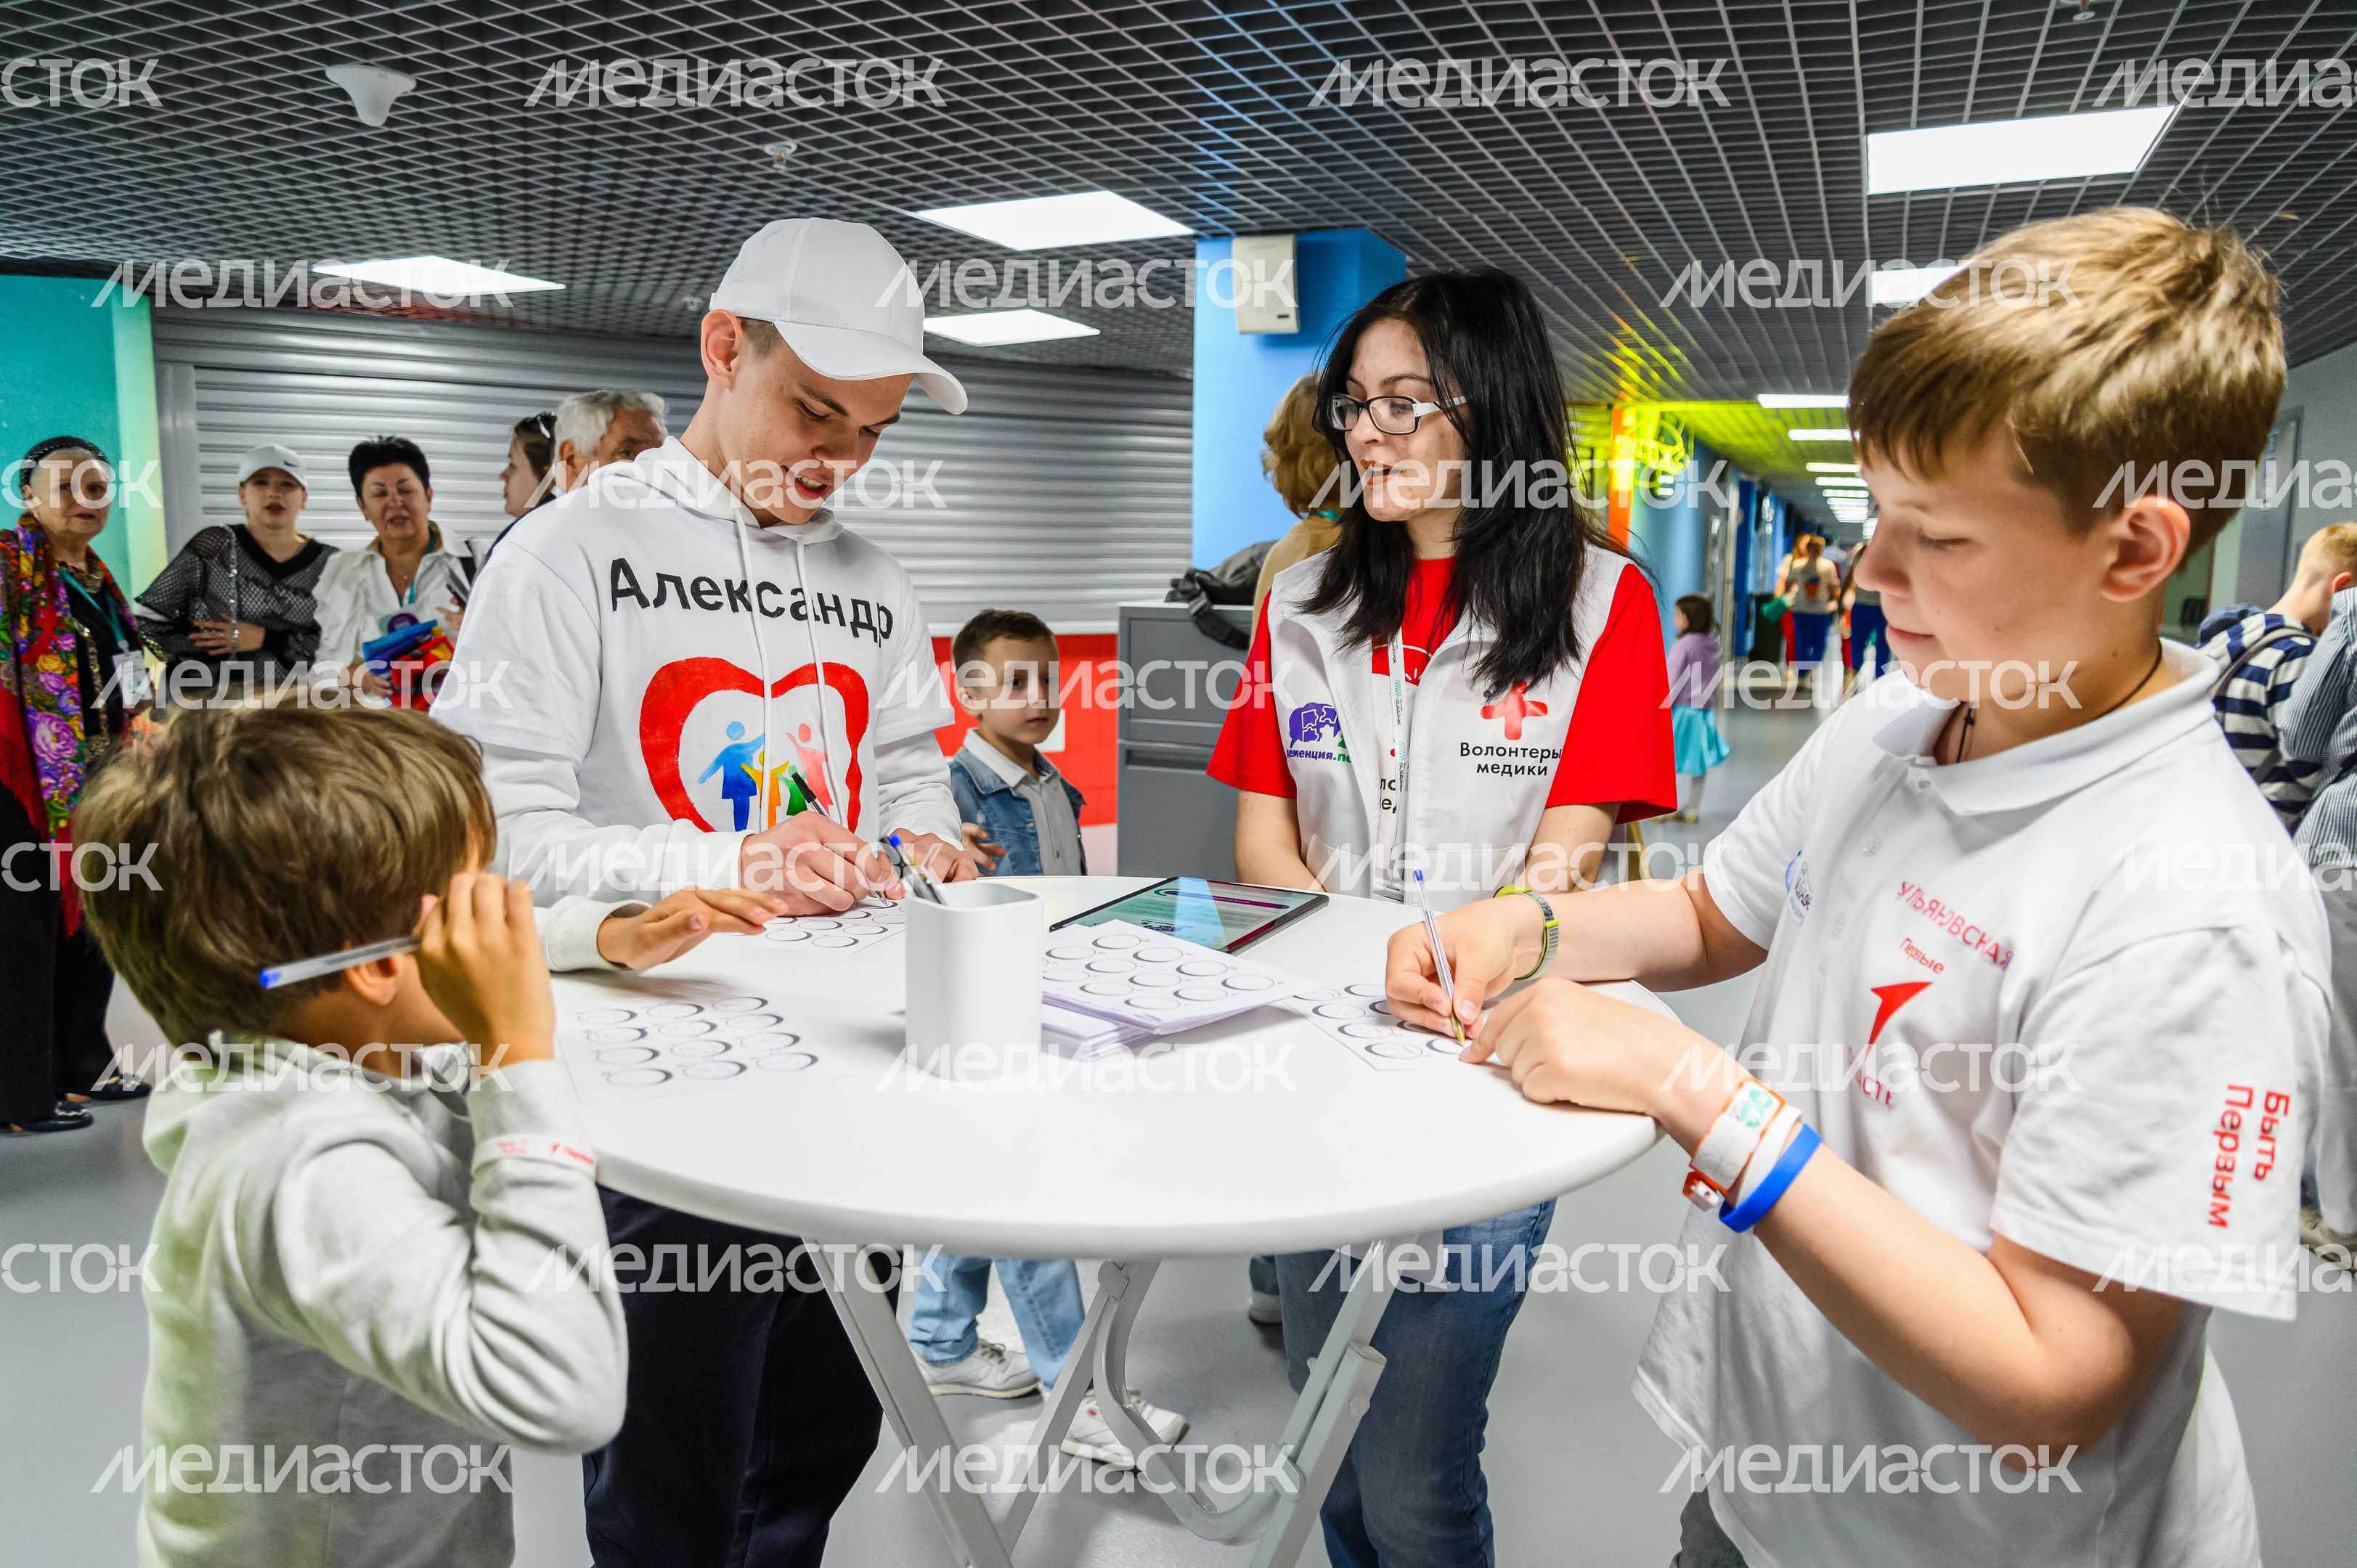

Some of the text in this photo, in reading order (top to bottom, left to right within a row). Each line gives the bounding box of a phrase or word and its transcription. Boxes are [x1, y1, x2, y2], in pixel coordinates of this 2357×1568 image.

[610, 558, 893, 648] Александр
[1460, 742, 1562, 763] Волонтеры
[1476, 763, 1547, 777] медики
[1899, 937, 1945, 974] Первые
[2208, 1085, 2255, 1228] Первым
[2254, 1090, 2291, 1180] Быть
